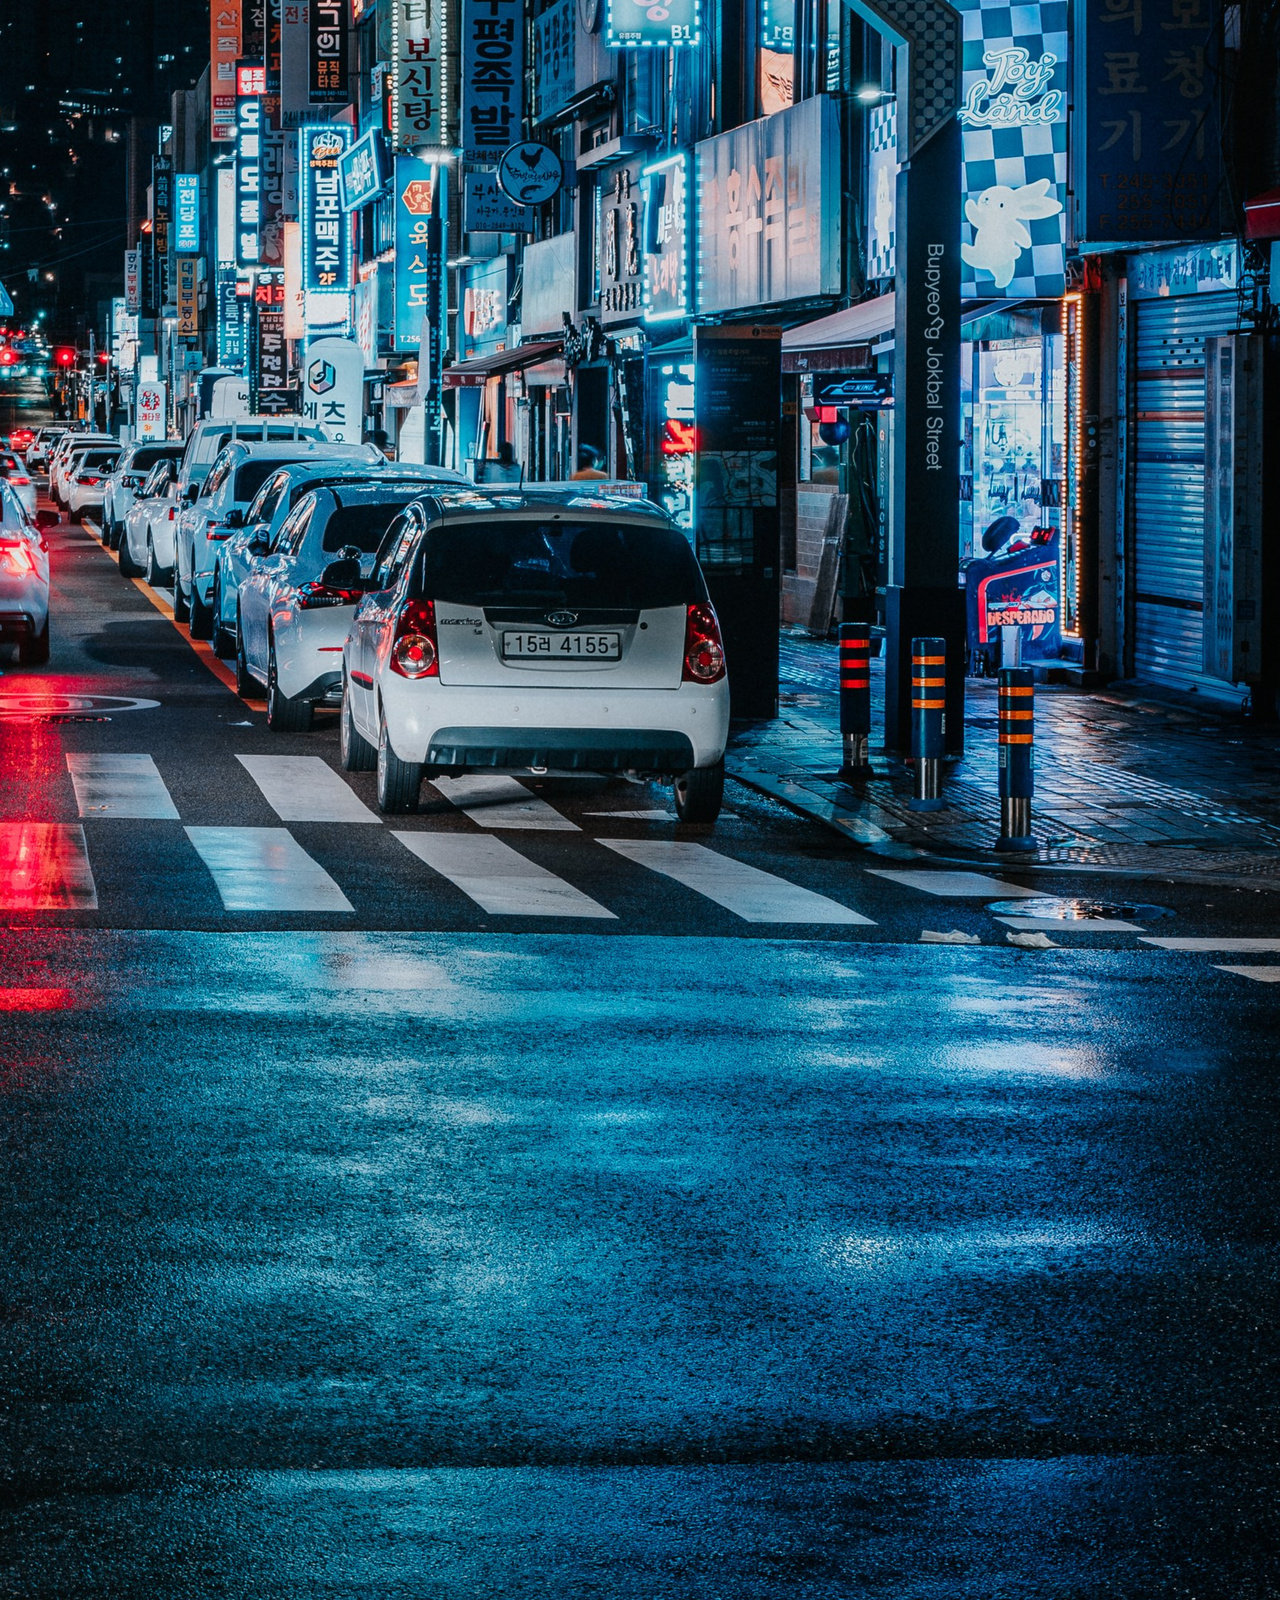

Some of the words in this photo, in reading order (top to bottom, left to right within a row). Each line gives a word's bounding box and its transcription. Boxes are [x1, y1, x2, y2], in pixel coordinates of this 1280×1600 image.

[671, 24, 692, 40] B1
[400, 37, 439, 131] 보신탕
[983, 47, 1057, 101] Toy
[957, 89, 1062, 127] Land
[403, 134, 420, 145] 2F
[177, 177, 198, 187] 신영
[179, 188, 196, 238] 전당포
[314, 169, 340, 271] 남포맥주
[180, 262, 195, 334] 대림부동산
[318, 272, 337, 285] 2F
[922, 243, 945, 338] Bupyeong
[926, 343, 945, 410] Jokbal
[926, 415, 945, 471] Street
[987, 607, 1056, 627] DESPERADO
[560, 636, 609, 654] 4155
